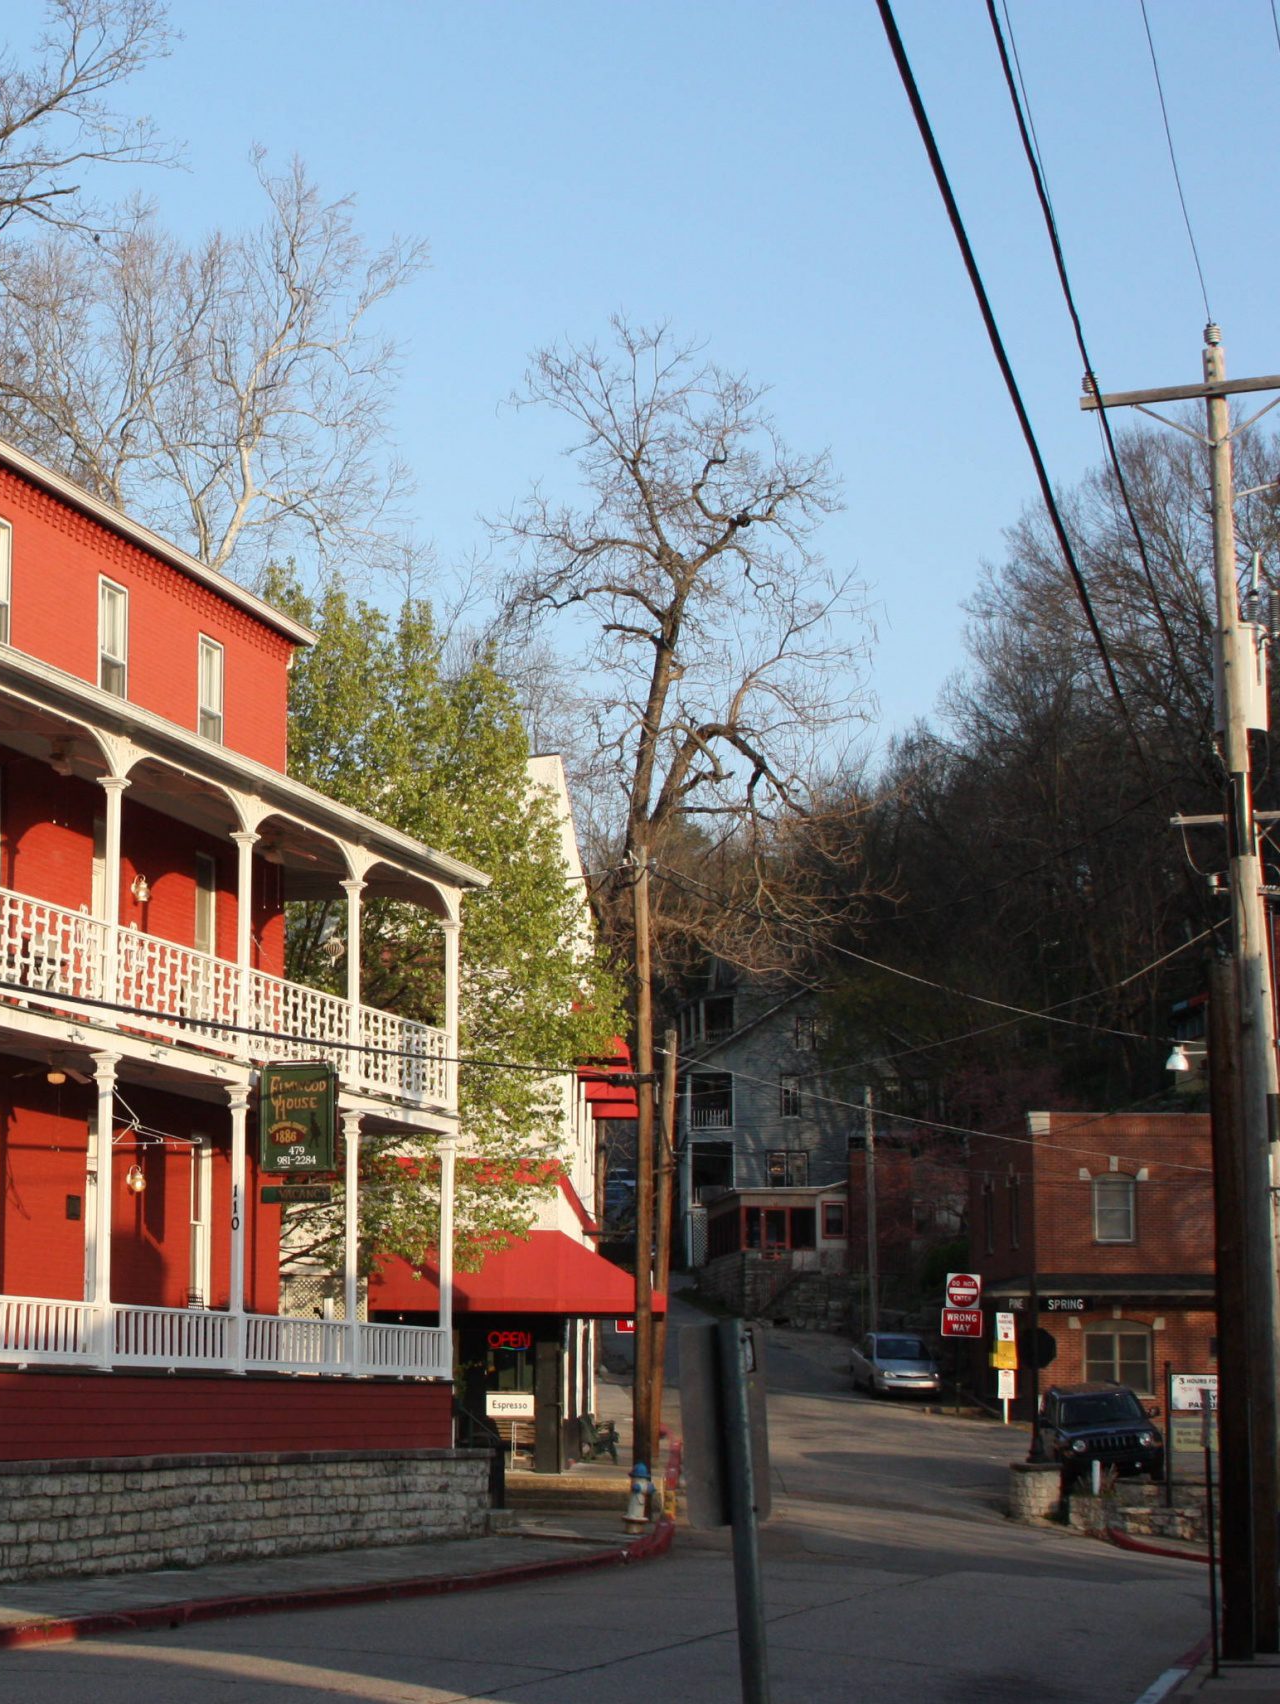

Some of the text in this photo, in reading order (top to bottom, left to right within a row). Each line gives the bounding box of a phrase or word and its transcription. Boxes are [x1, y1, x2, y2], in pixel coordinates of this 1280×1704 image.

[271, 1095, 318, 1120] HOUSE
[275, 1129, 297, 1143] 1886
[288, 1146, 305, 1155] 479
[276, 1155, 317, 1165] 981-2284
[963, 1280, 975, 1288] NOT
[1008, 1298, 1024, 1310] PINE
[1047, 1298, 1084, 1310] SPRING
[946, 1313, 978, 1322] WRONG
[952, 1323, 971, 1332] WAY
[487, 1331, 532, 1348] OPEN
[1179, 1377, 1185, 1385] 3
[492, 1400, 528, 1411] Espresso
